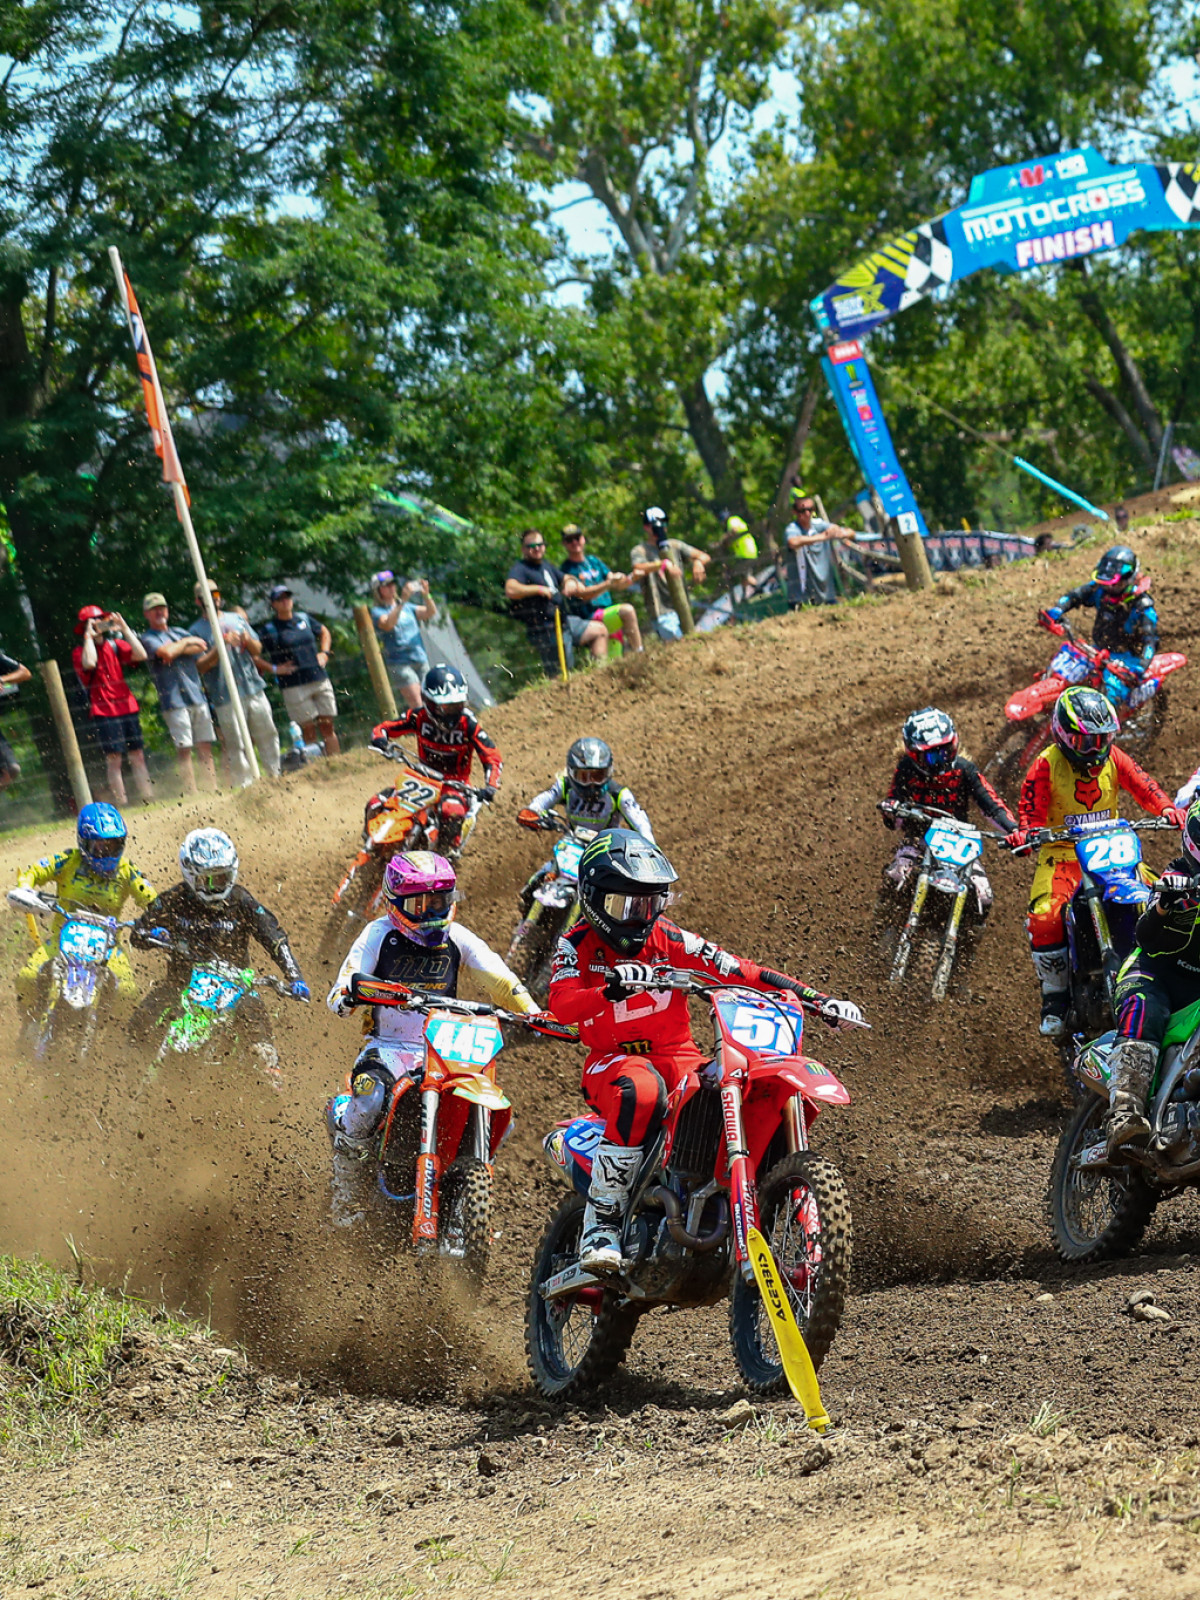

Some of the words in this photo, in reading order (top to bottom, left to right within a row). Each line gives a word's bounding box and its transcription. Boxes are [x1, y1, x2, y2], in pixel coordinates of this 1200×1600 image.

[962, 178, 1146, 244] MOTOCROSS
[1016, 219, 1115, 268] FINISH
[421, 722, 464, 745] FXR
[399, 780, 435, 808] 22
[1075, 809, 1111, 826] YAMAHA
[929, 829, 981, 867] 50
[1085, 834, 1135, 872] 28
[433, 1021, 497, 1062] 445
[731, 1005, 798, 1055] 51
[722, 1091, 738, 1141] SHOWA
[422, 1157, 434, 1219] DUNLOP
[757, 1252, 787, 1322] ACERBIS
